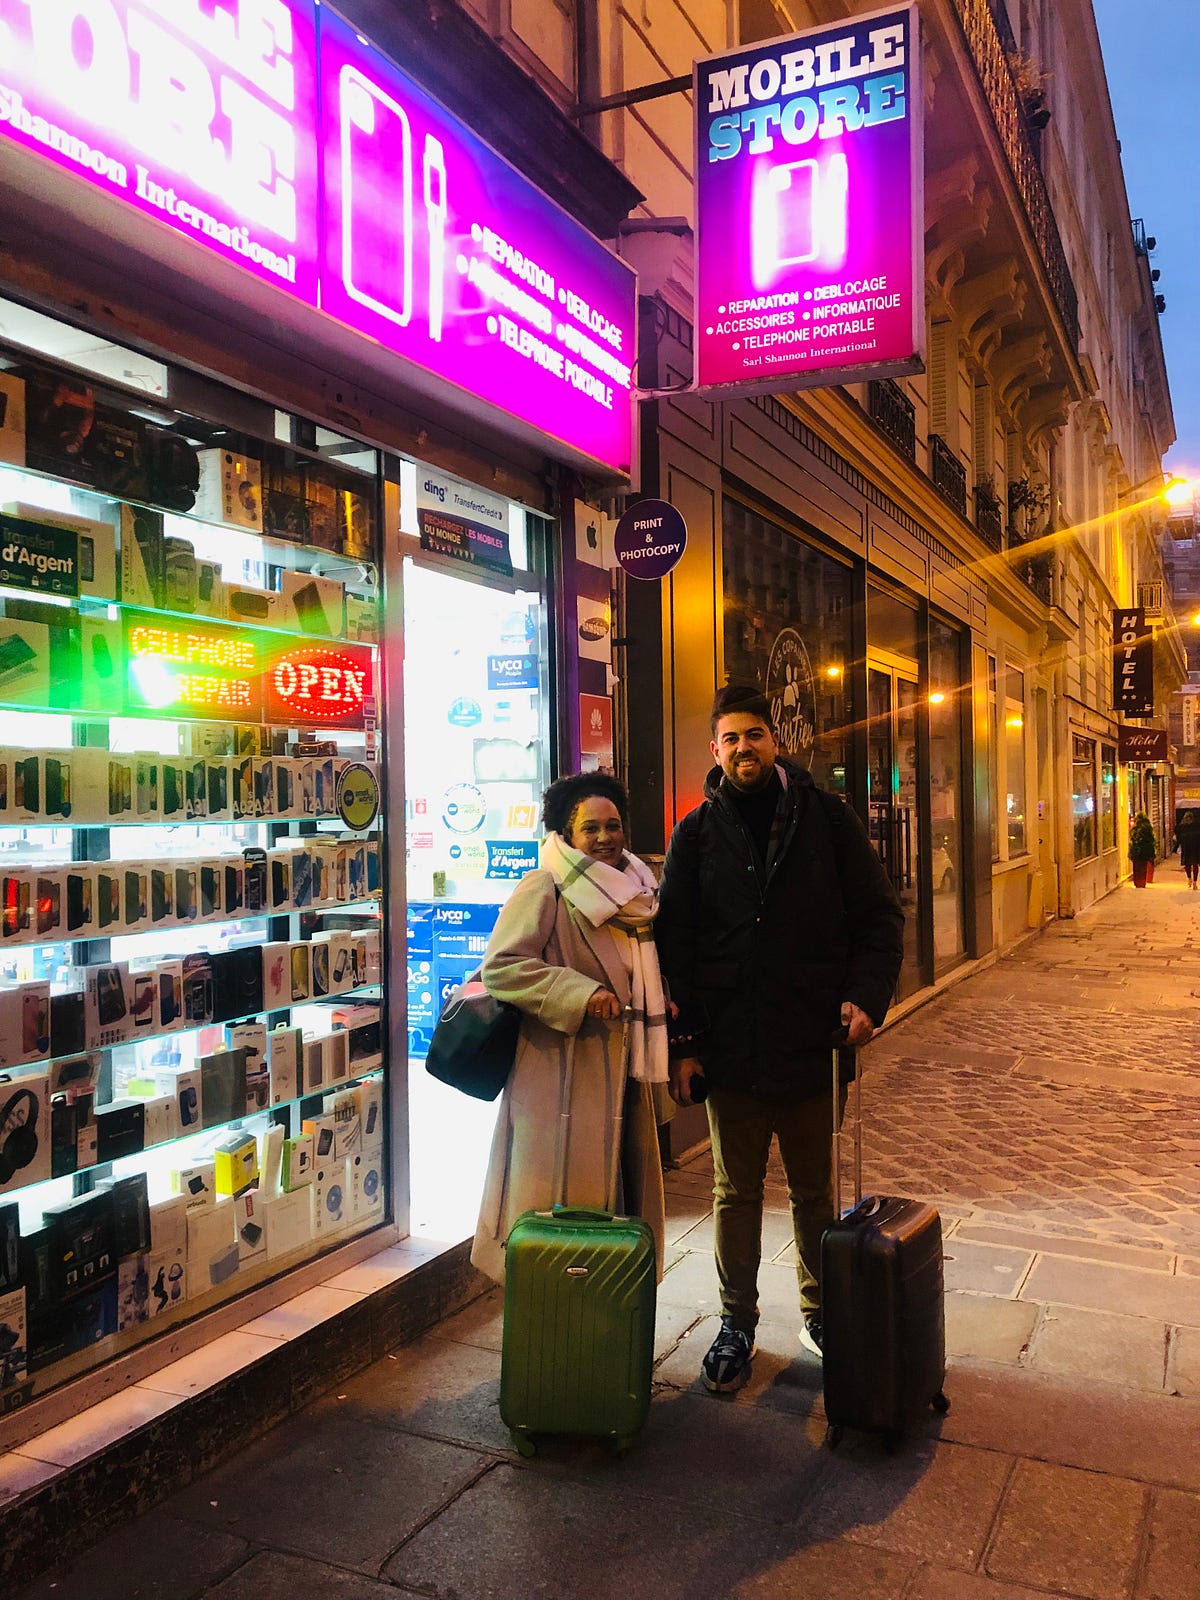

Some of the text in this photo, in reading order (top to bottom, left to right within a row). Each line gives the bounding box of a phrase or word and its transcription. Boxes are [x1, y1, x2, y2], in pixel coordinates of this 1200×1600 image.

[708, 23, 905, 113] MOBILE
[709, 71, 906, 163] STORE
[135, 164, 296, 283] International
[728, 276, 887, 314] REPARATION DEBLOCAGE
[715, 293, 901, 335] ACCESSOIRES INFORMATIQUE
[743, 317, 875, 350] TELEPHONE PORTABLE
[743, 339, 877, 367] Sarl Shannon International
[424, 480, 445, 502] ding
[424, 513, 504, 549] RECHARGEZ LES MOBILES
[424, 524, 461, 545] DU MONDE
[634, 517, 663, 530] PRINT
[645, 533, 653, 543] &
[2, 543, 74, 573] d'Argent
[620, 543, 681, 561] PHOTOCOPY
[491, 659, 522, 673] Lyca
[1121, 616, 1138, 690] HOTEL
[274, 661, 366, 702] OPEN
[491, 846, 524, 856] Transfert
[491, 856, 536, 870] d'Argent
[437, 909, 463, 921] Lyca
